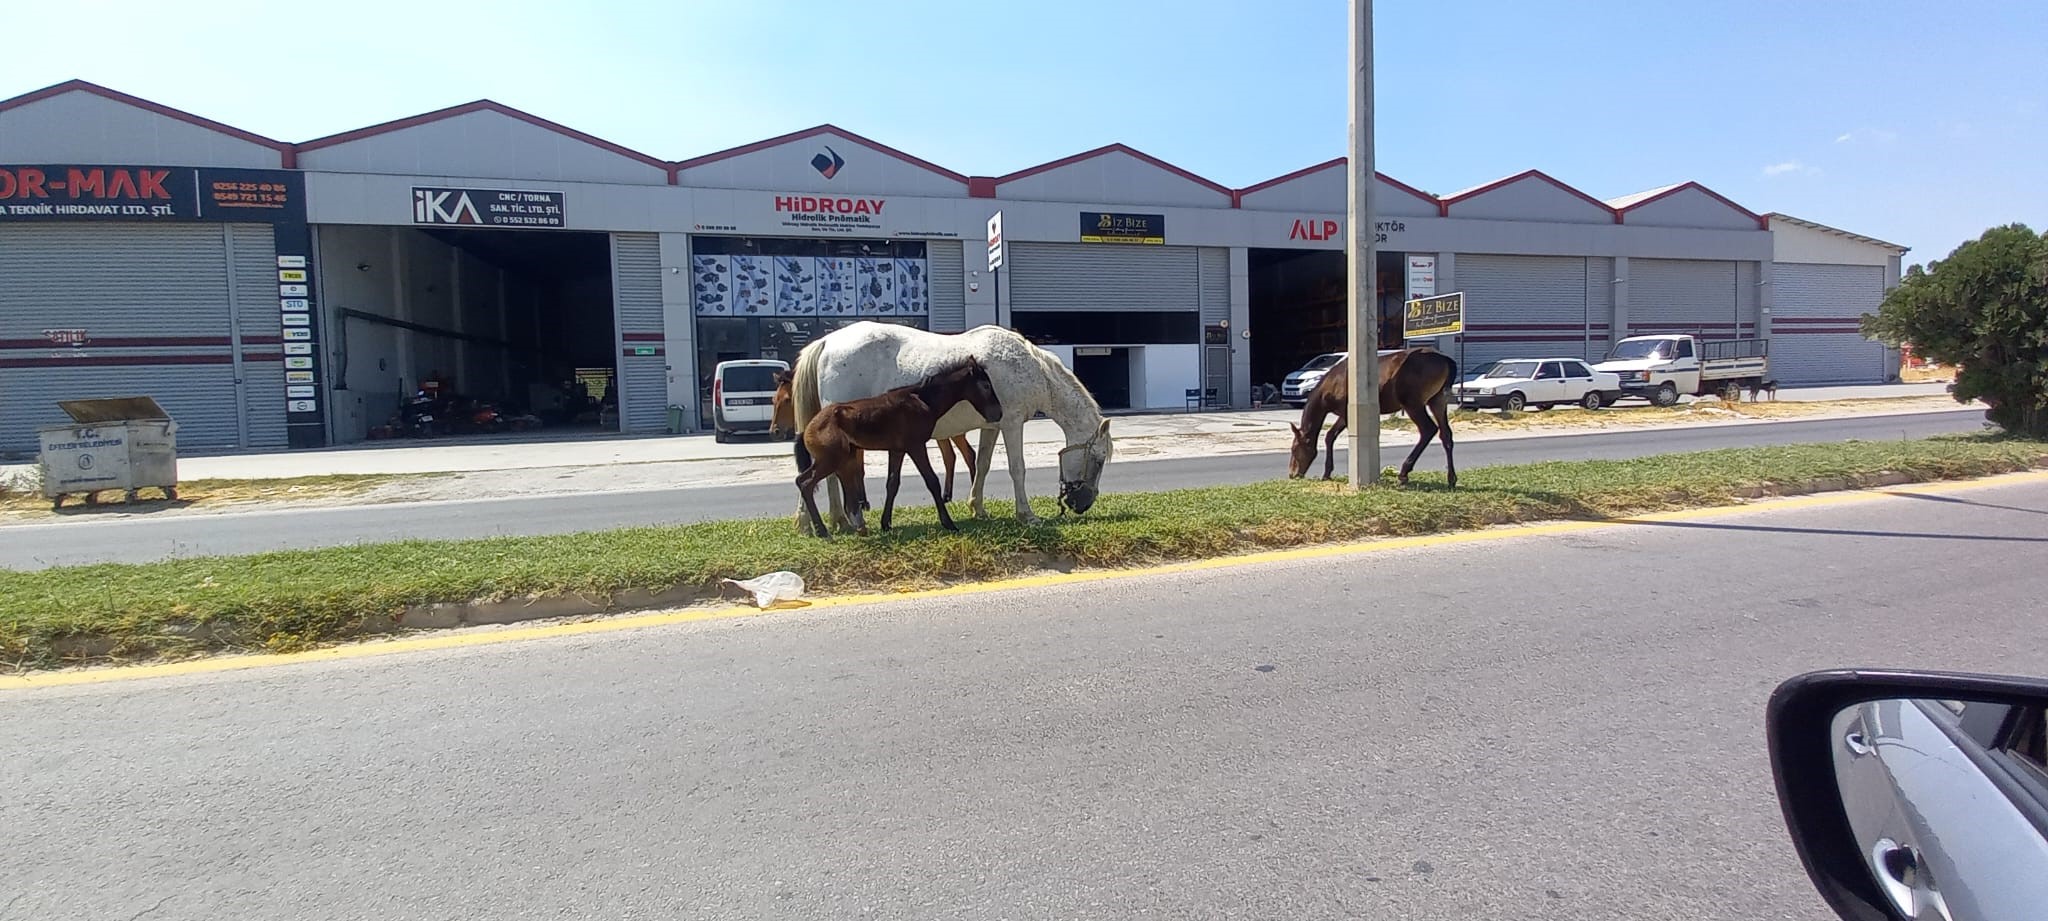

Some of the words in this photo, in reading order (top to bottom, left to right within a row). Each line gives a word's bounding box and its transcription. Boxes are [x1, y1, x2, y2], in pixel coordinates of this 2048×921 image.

[499, 193, 516, 201] CNC
[524, 194, 551, 202] TORNA
[9, 203, 54, 215] TEKNİK
[56, 204, 122, 215] HIRDAVAT
[123, 206, 149, 215] LTD.
[151, 204, 175, 217] ŞTİ.
[490, 204, 509, 212] SAN.
[512, 203, 527, 213] TİC.
[528, 205, 545, 214] LTD.
[546, 205, 561, 216] ŞTİ.
[509, 216, 522, 224] 552
[791, 213, 827, 222] Hidrolik
[829, 214, 870, 223] Pnömatik
[1289, 219, 1338, 241] ALP
